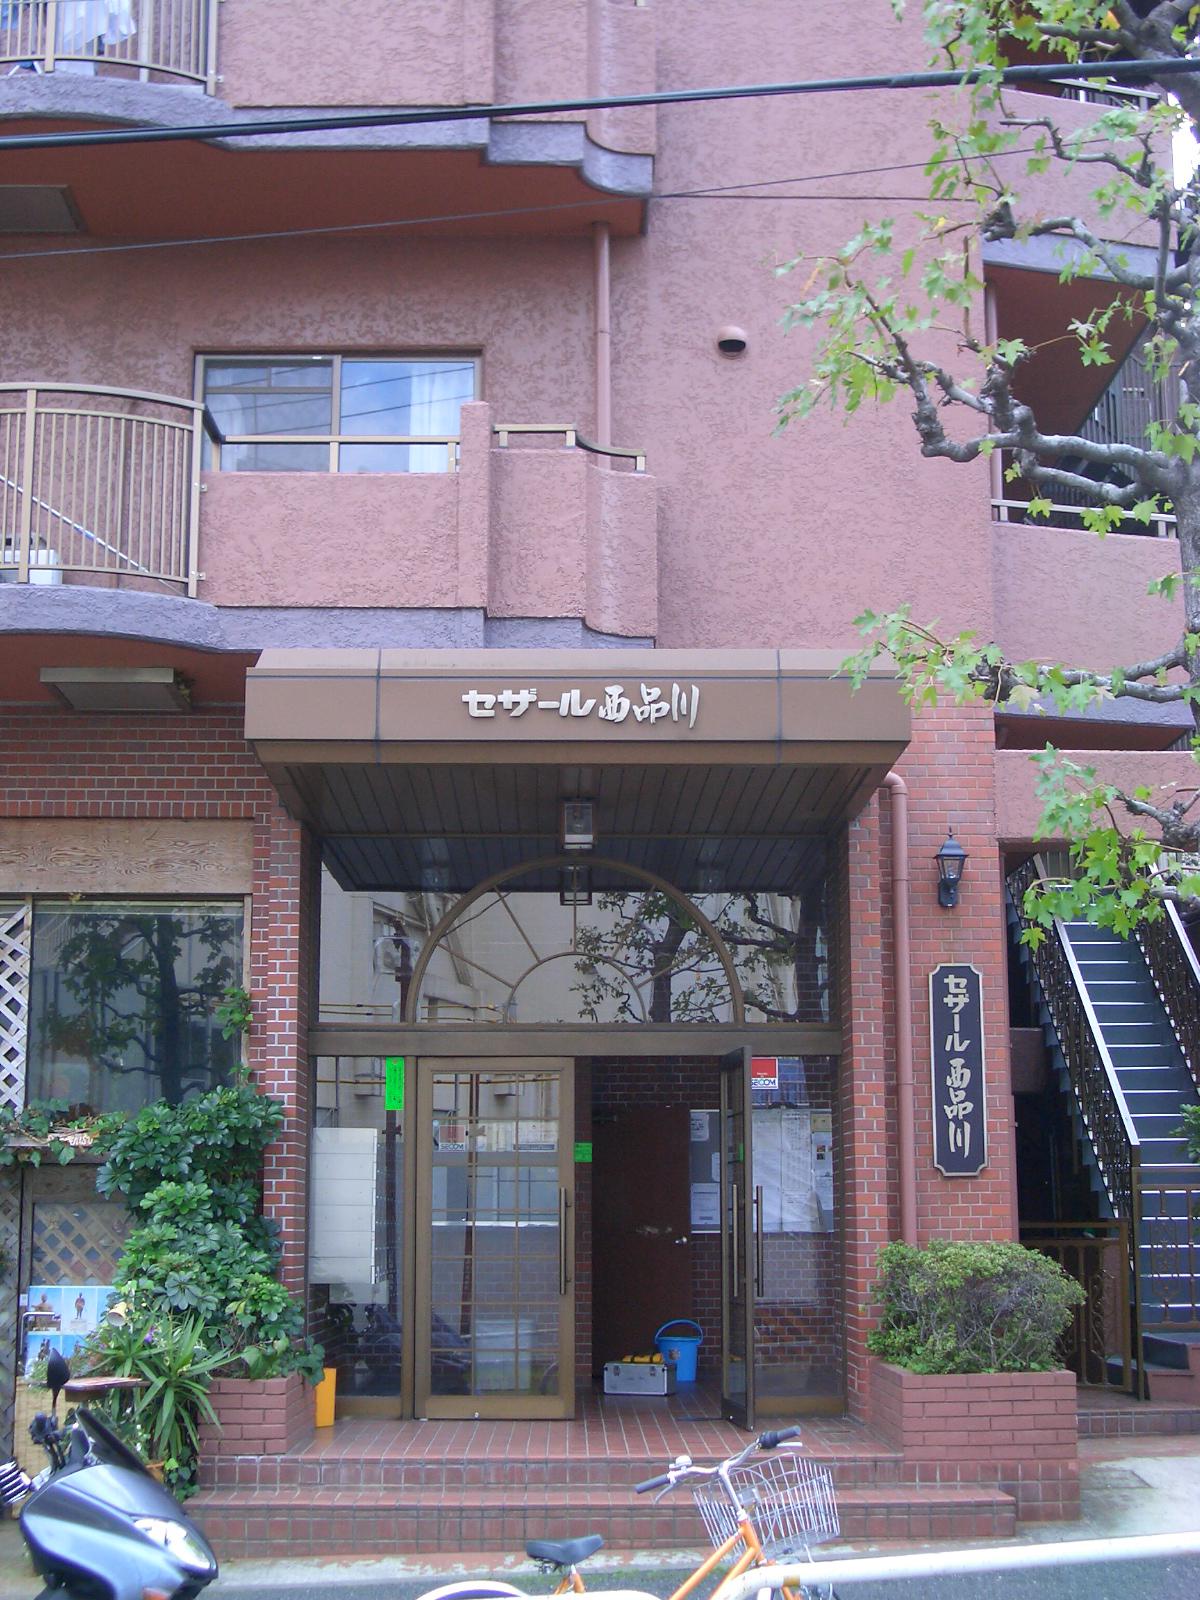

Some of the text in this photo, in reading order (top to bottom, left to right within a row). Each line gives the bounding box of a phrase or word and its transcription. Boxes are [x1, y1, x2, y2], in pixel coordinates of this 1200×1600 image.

[462, 682, 700, 729] セザール西品川
[943, 974, 974, 1158] セザール西品川
